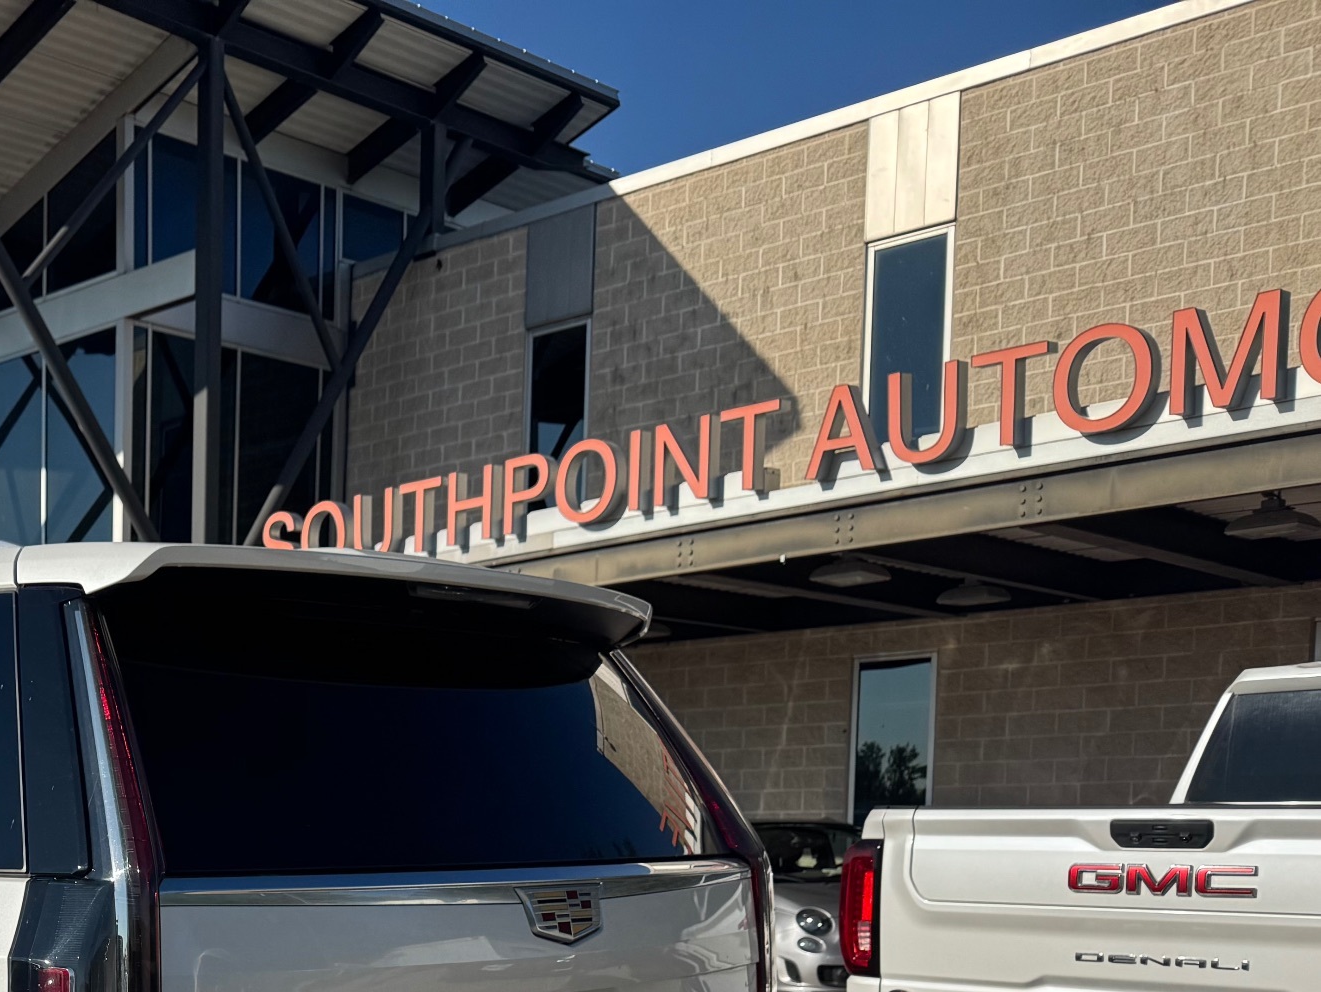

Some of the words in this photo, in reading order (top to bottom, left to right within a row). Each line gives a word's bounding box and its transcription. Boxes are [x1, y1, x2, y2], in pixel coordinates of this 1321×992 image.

[262, 400, 780, 552] SOUTHPOINT
[805, 288, 1321, 480] AUTOM
[1067, 862, 1259, 898] GMC
[1075, 951, 1250, 972] DENALI
